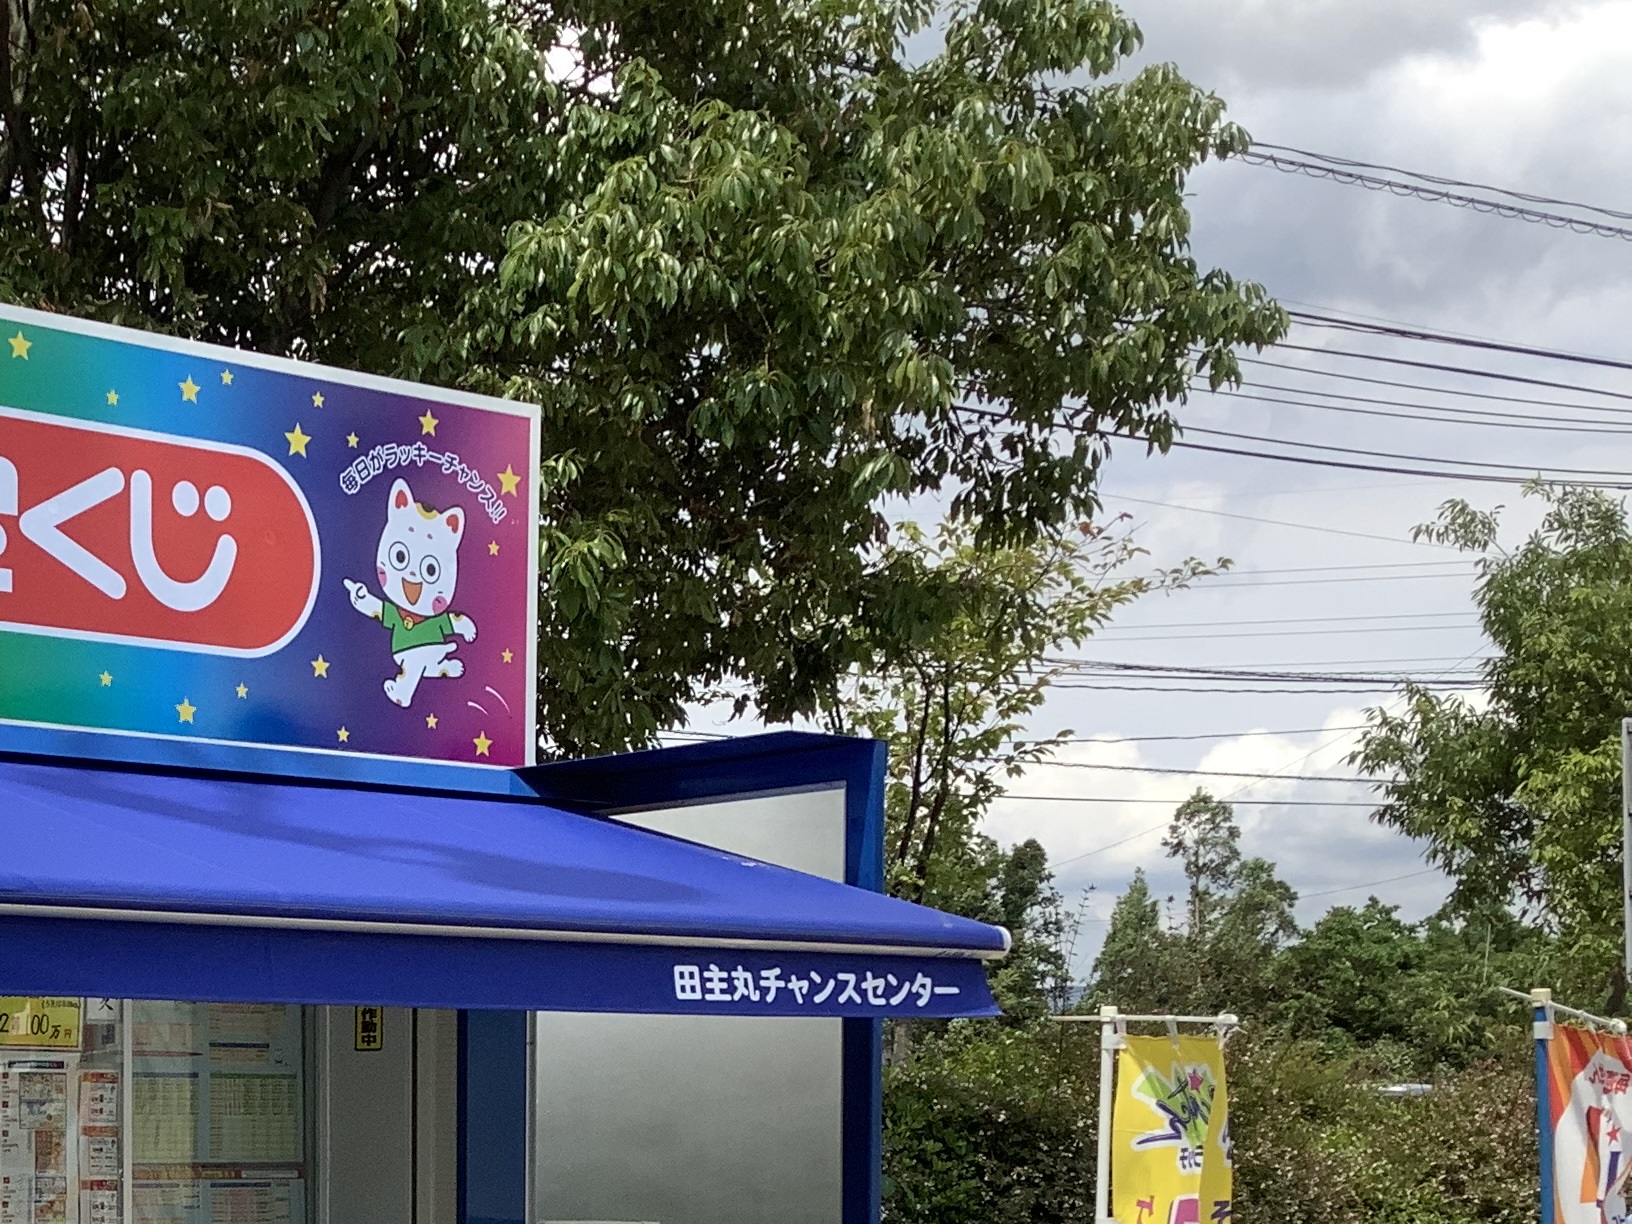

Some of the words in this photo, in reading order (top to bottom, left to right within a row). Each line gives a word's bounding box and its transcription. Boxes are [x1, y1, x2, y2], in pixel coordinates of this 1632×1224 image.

[673, 964, 960, 1007] 田主丸チャンスセンター
